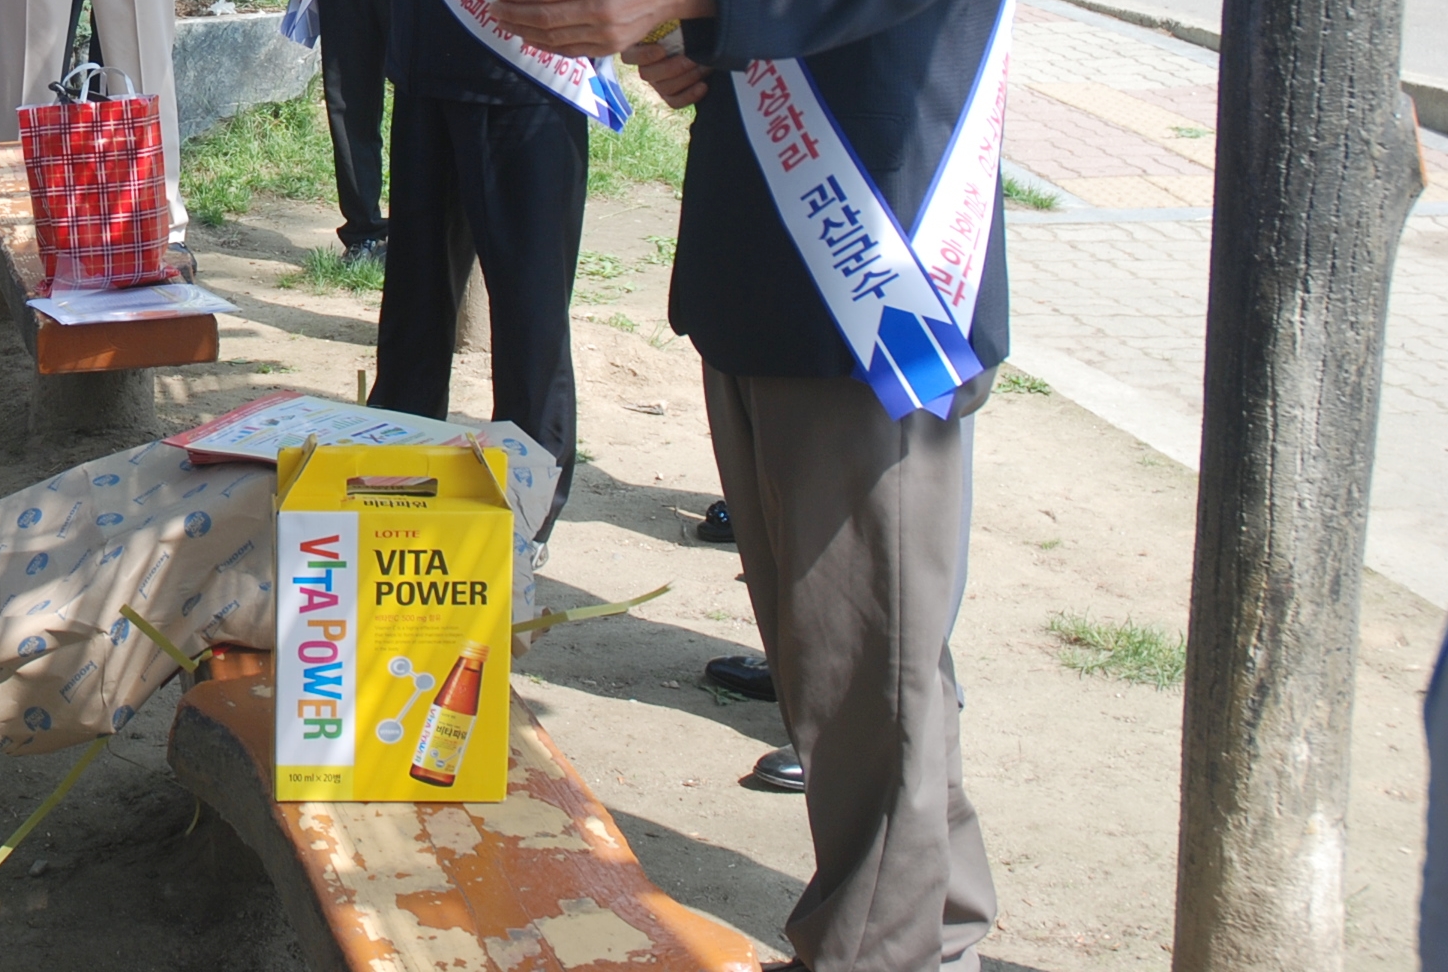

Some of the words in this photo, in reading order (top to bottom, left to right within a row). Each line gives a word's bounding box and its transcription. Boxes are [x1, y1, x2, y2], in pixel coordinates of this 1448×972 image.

[800, 174, 900, 302] 괴산군수
[363, 499, 428, 509] 비타파워
[375, 530, 420, 539] LOTTE
[292, 535, 347, 614] VITA
[373, 549, 449, 576] VITA
[374, 581, 488, 606] POWER
[297, 620, 347, 740] POWER
[289, 774, 302, 782] 100
